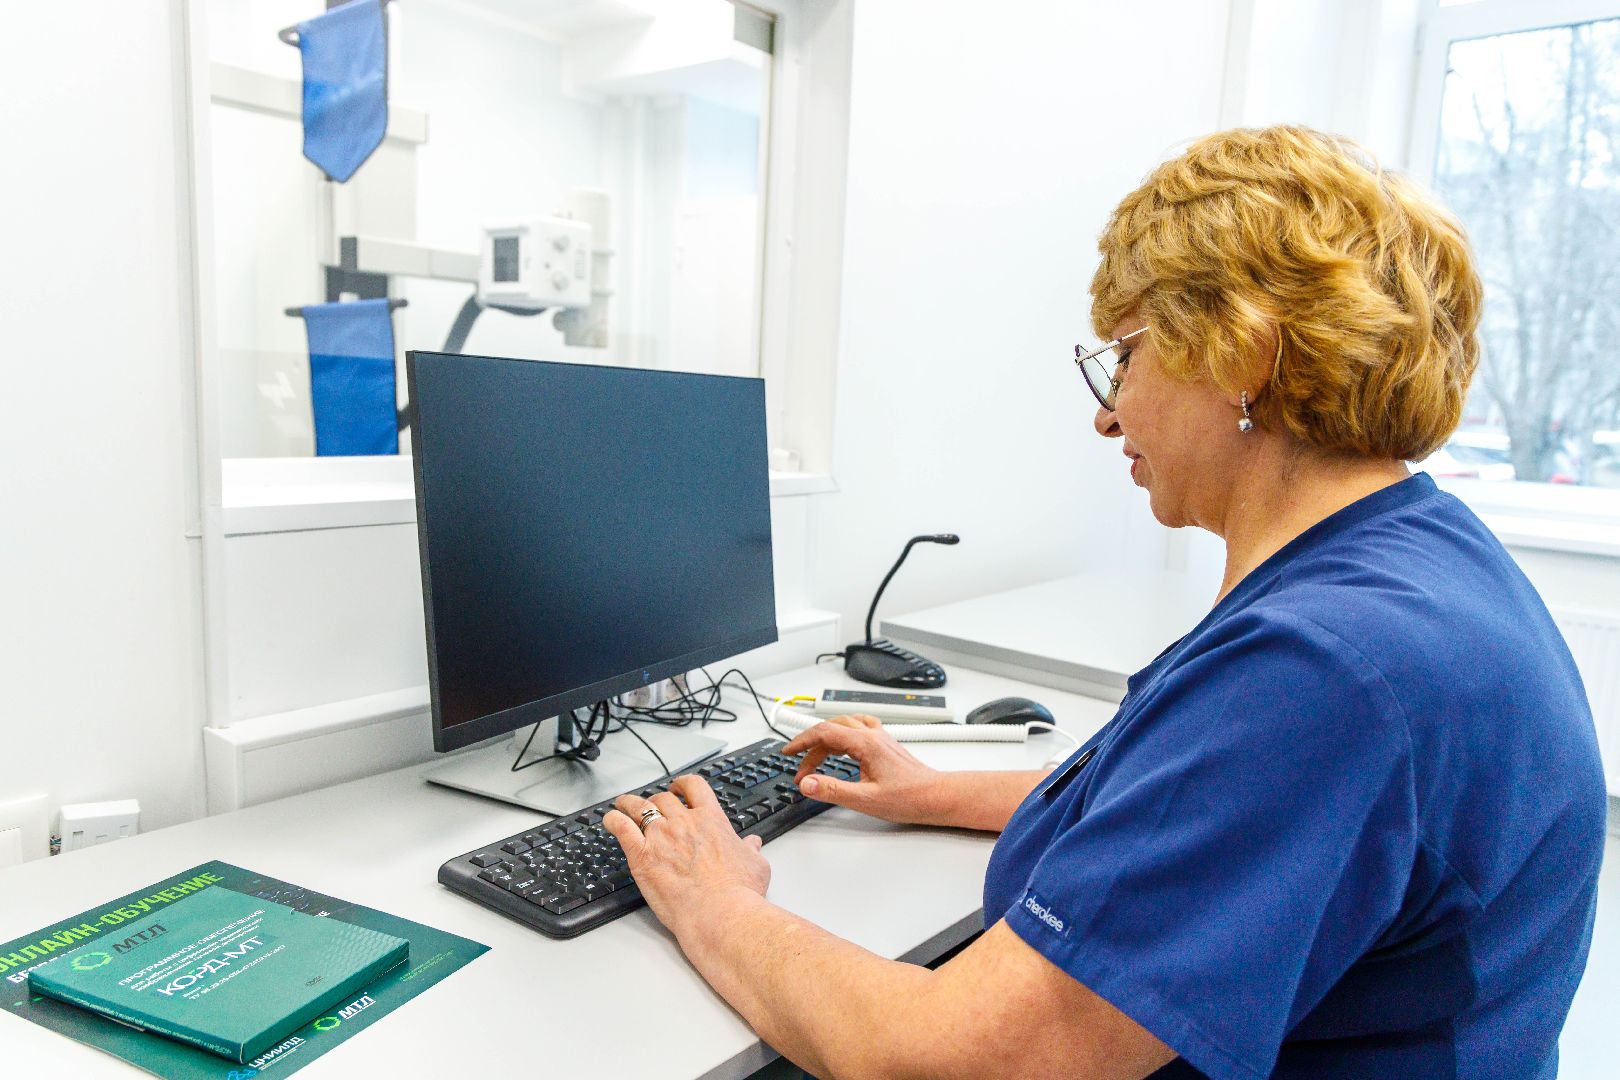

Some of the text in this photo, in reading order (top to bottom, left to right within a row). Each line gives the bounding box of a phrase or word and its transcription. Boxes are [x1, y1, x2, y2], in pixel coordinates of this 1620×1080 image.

[1026, 896, 1064, 931] cherokee
[112, 924, 167, 954] МТЛ
[118, 943, 198, 986] ПРОГРАММНОЕ
[157, 935, 263, 996] КОРД-МТ
[339, 995, 375, 1019] МТЛ
